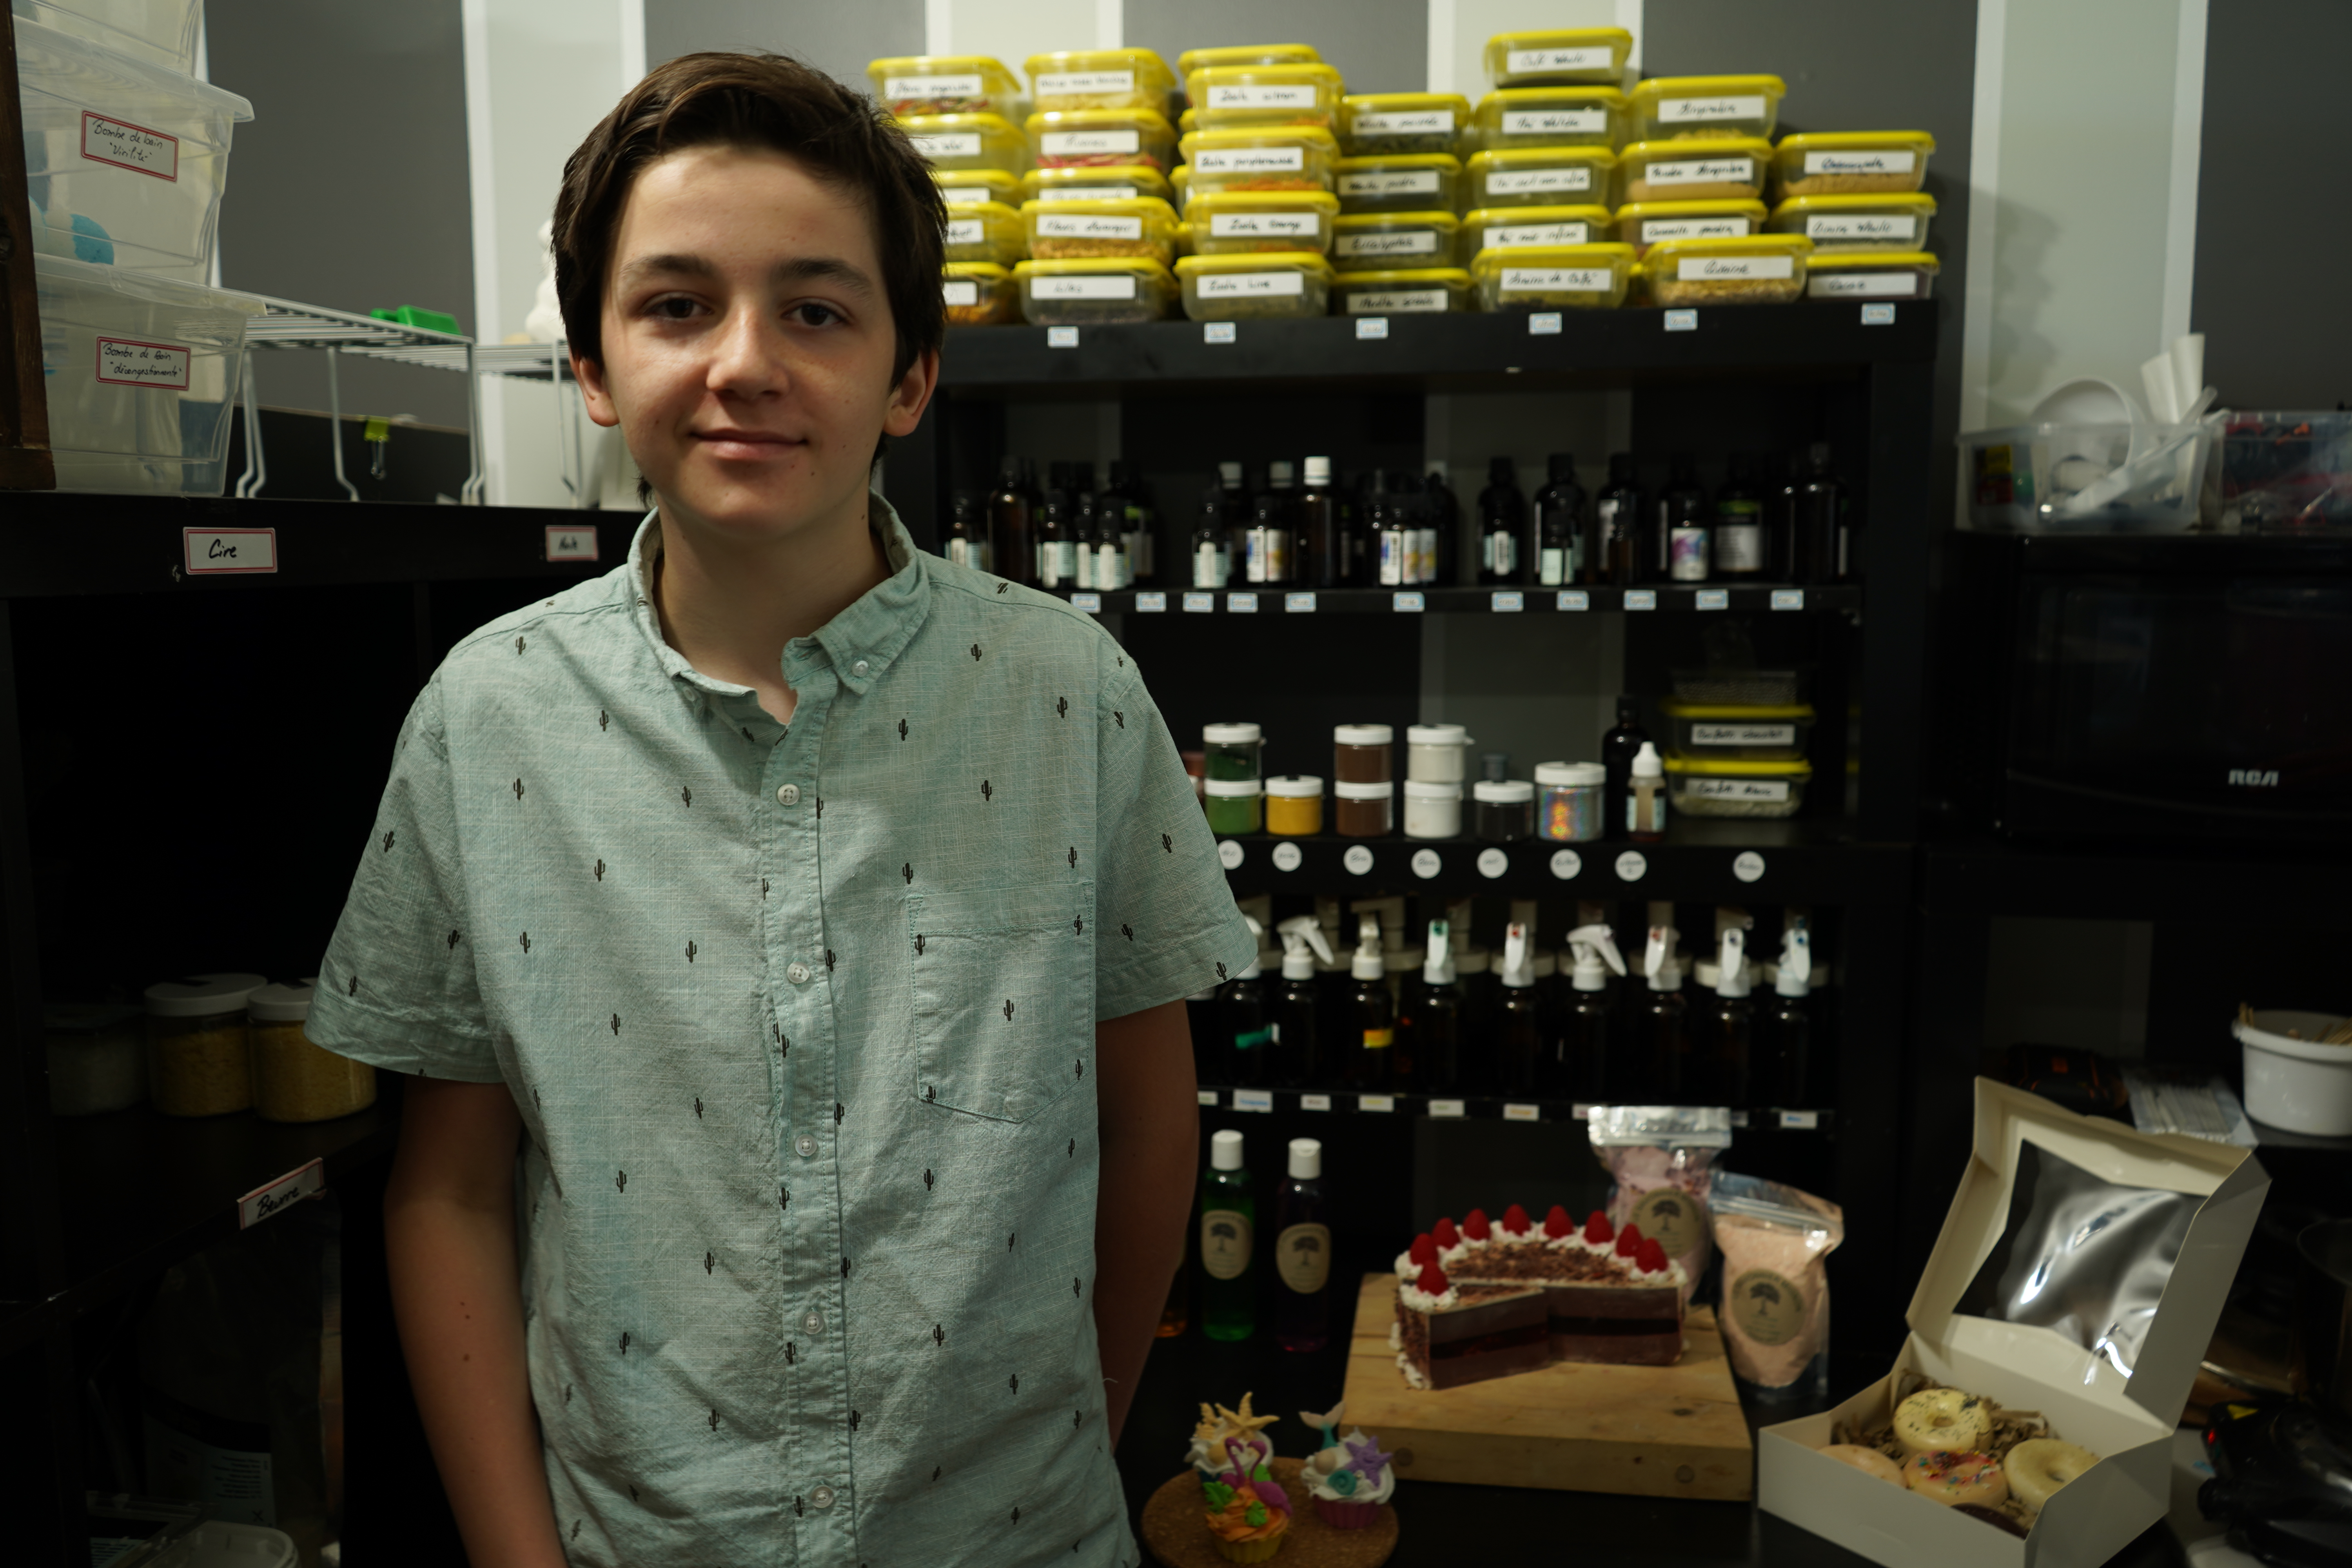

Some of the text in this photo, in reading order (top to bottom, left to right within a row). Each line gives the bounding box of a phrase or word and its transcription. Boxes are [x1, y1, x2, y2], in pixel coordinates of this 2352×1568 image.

[92, 118, 125, 141] Bombe
[130, 131, 142, 143] de
[102, 343, 134, 359] Bombe
[139, 347, 149, 359] de
[209, 539, 238, 559] Cire
[2228, 769, 2279, 787] RCA
